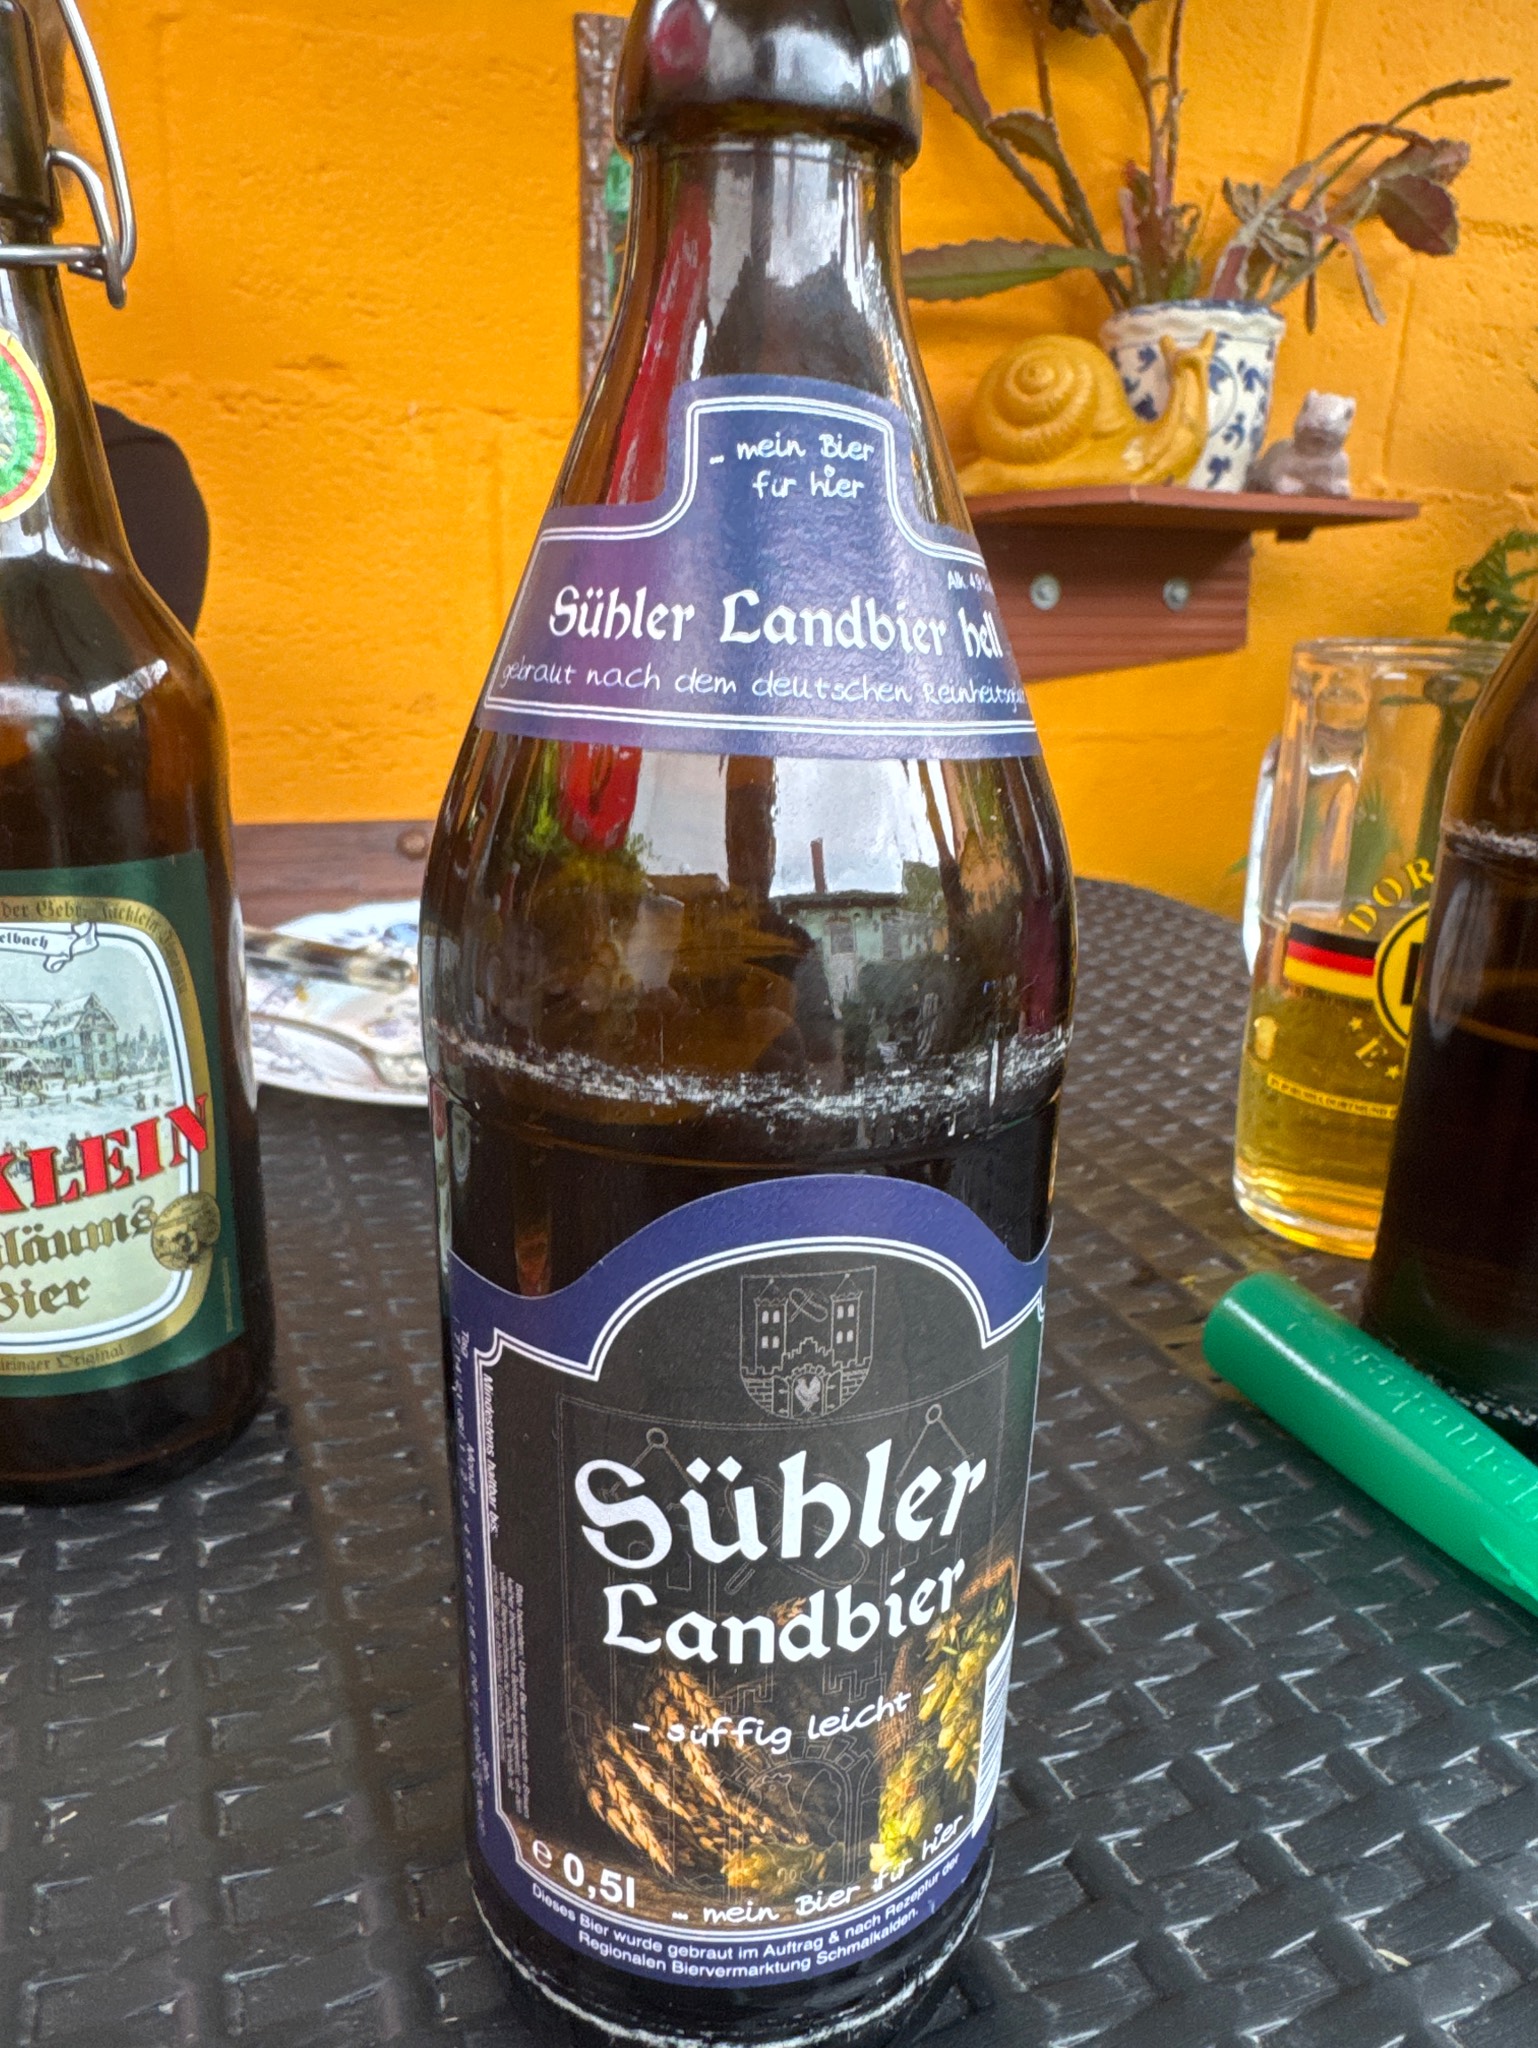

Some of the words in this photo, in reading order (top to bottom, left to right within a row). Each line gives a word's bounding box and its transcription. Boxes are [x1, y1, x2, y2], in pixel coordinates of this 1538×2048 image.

[737, 431, 806, 460] mein
[818, 433, 874, 461] Bier
[810, 464, 865, 499] hier
[549, 585, 695, 641] Sühler
[720, 589, 947, 656] Landbier
[957, 607, 1003, 659] hell
[499, 655, 576, 690] gebraut
[586, 662, 660, 690] nach
[675, 668, 736, 695] dem
[752, 670, 912, 702] deutschen
[0, 1196, 158, 1270] läums
[574, 1438, 987, 1569] Sühler
[602, 1558, 965, 1664] Landbier
[666, 1714, 792, 1755] süffig
[807, 1693, 912, 1740] leicht
[563, 1852, 635, 1908] 0,5l
[703, 1900, 779, 1924] mein
[795, 1884, 860, 1916] Bier
[922, 1815, 964, 1861] hier
[532, 1882, 576, 1922] Dieses
[580, 1913, 609, 1936] Bier
[613, 1929, 663, 1952] wurde
[668, 1943, 734, 1961] gebraut
[738, 1944, 758, 1960] im
[763, 1936, 824, 1957] Auftrag
[828, 1930, 840, 1944] &
[845, 1911, 881, 1938] nach
[885, 1872, 940, 1920] Rezeptur
[941, 1852, 960, 1876] der
[578, 1930, 667, 1971] Regionalen
[672, 1956, 811, 1978] Biervermarktung
[816, 1908, 919, 1965] Schmalkalden.
